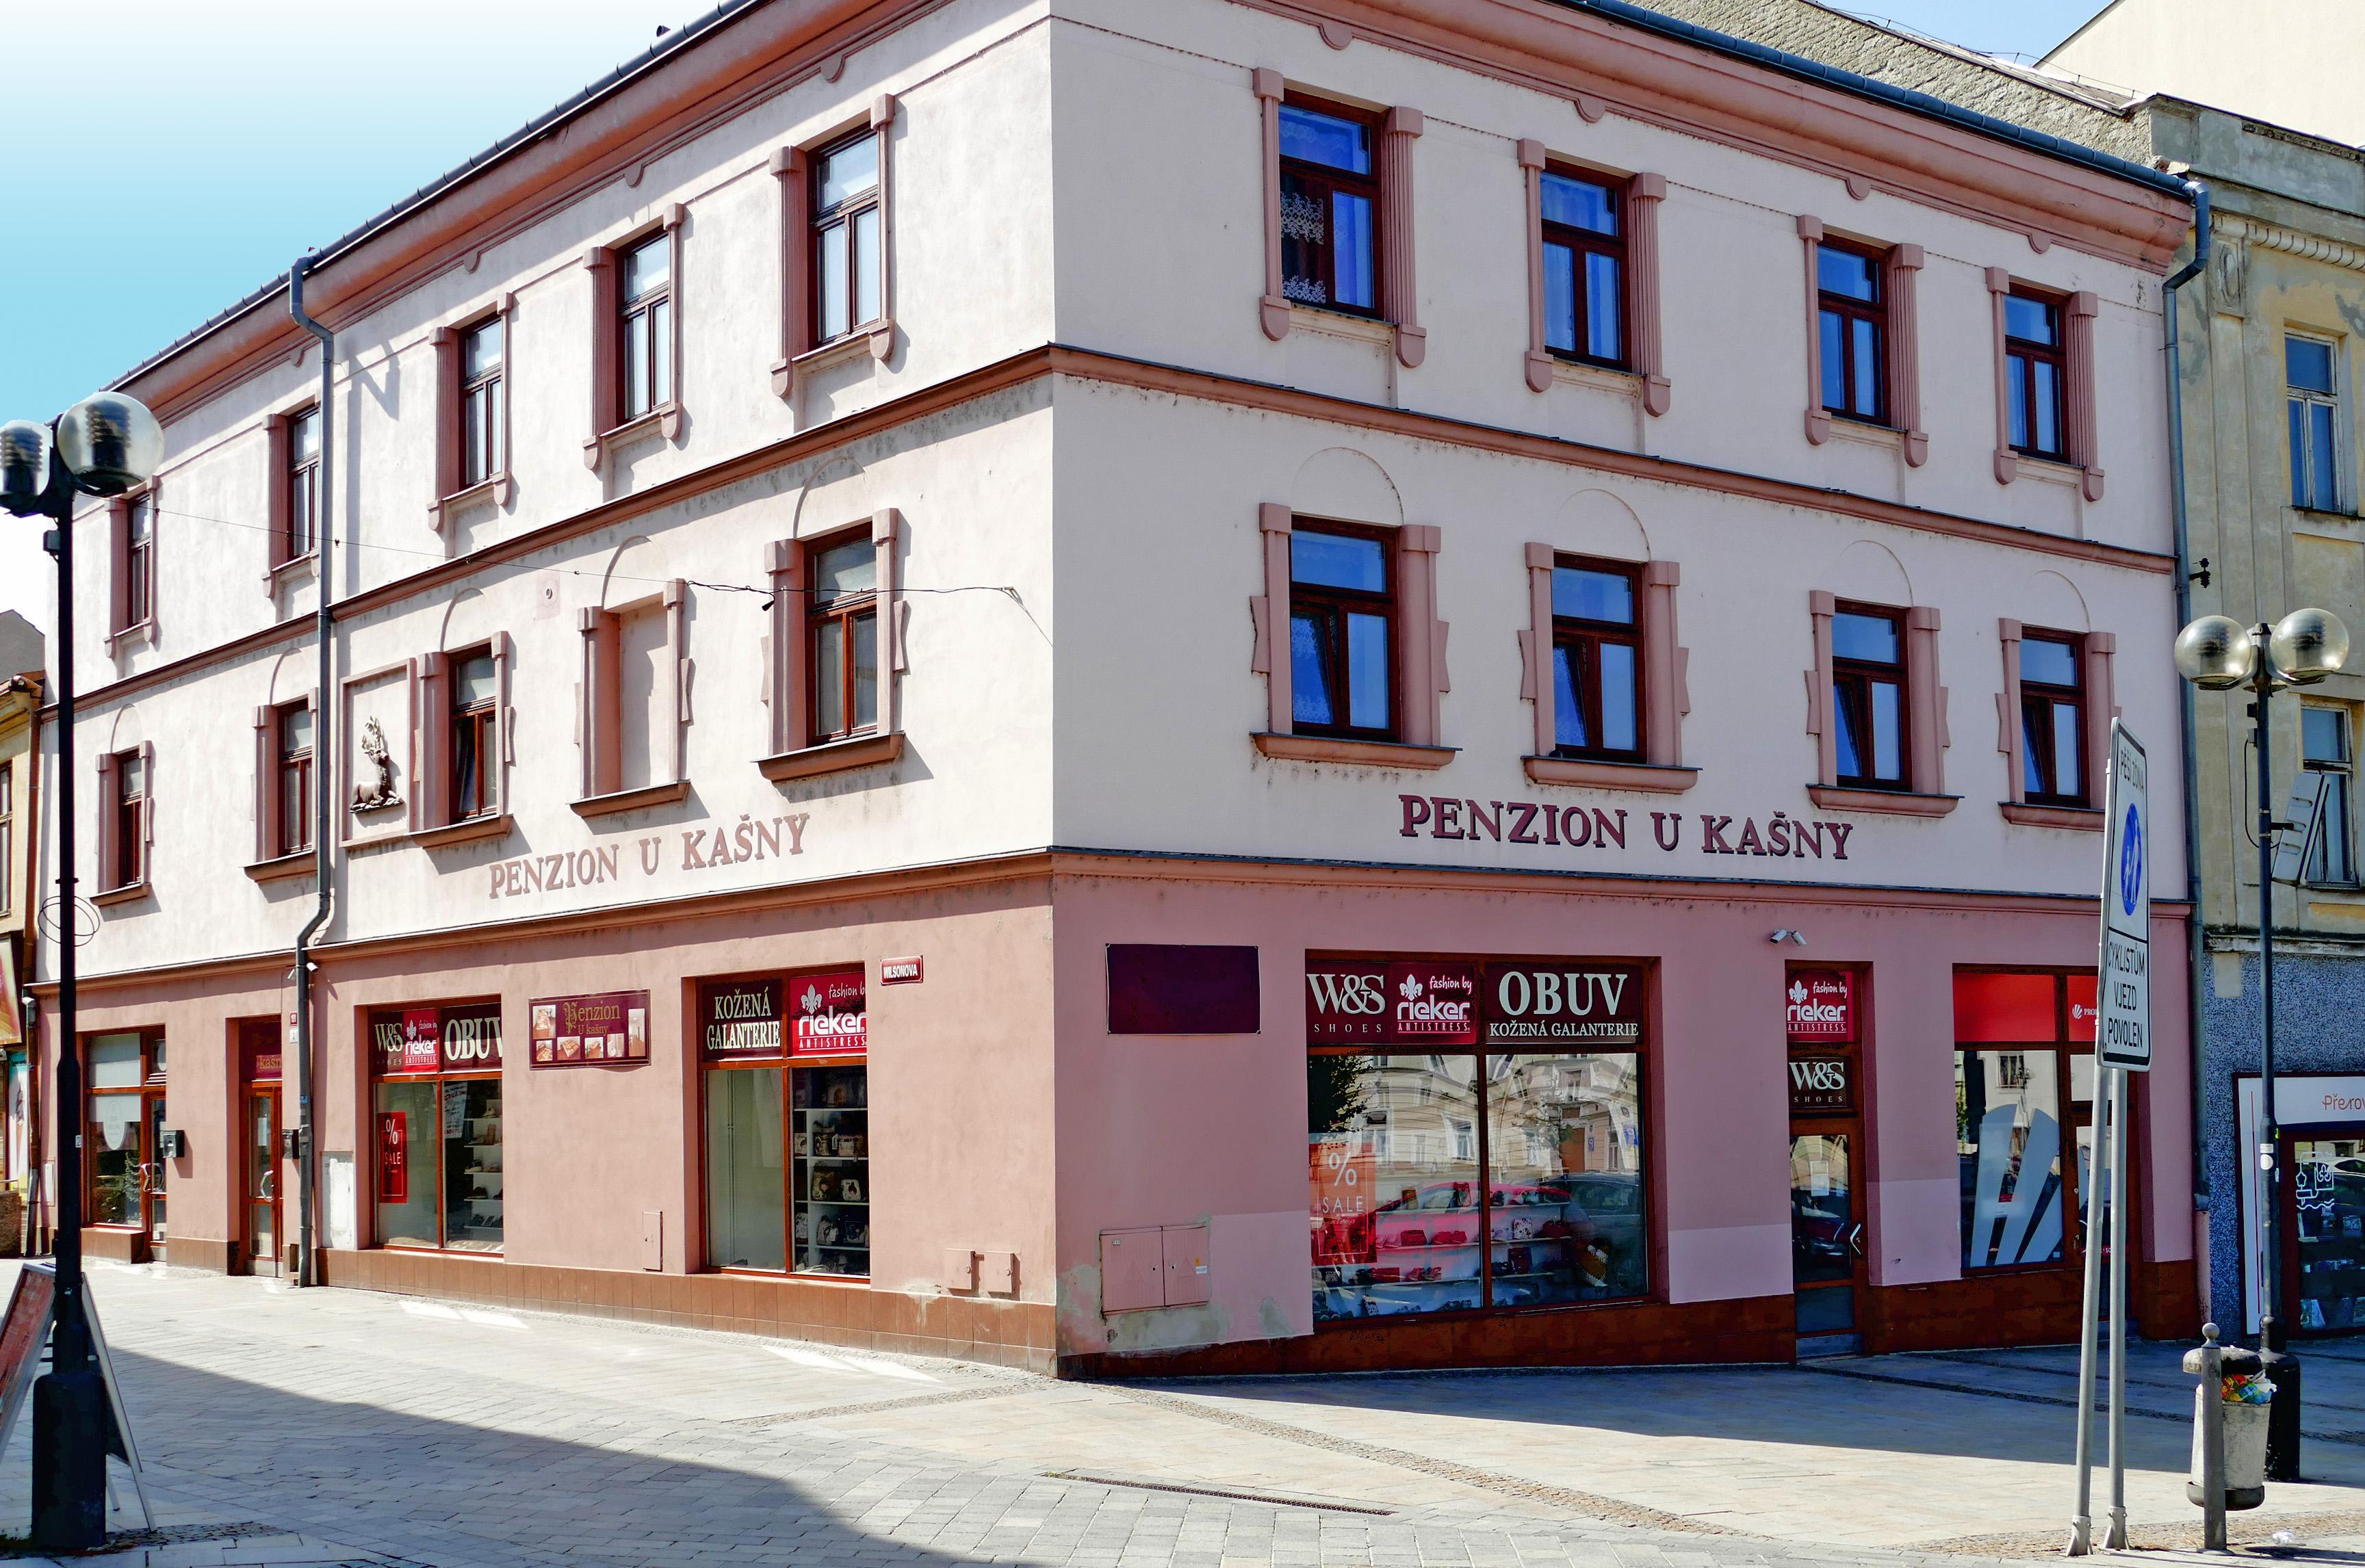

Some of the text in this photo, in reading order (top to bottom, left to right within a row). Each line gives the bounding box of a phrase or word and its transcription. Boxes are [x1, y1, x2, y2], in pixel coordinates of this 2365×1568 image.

[1398, 794, 1853, 860] PENZION U KAŠNY
[489, 813, 810, 899] PENZION U KAŠNY
[2108, 941, 2145, 977] CYKLISTŮM
[883, 964, 918, 978] WILSONOVA
[829, 980, 866, 999] fashion b
[1430, 975, 1472, 995] fashion by
[1499, 971, 1627, 1015] OBUV
[1813, 981, 1847, 998] fashion by
[714, 986, 771, 1019] KOŽENÁ
[2114, 981, 2136, 1011] VJEZD
[563, 1000, 621, 1034] Penzion
[1397, 995, 1471, 1020] rieker
[1787, 998, 1846, 1021] rieker
[586, 1024, 608, 1036] kašny
[707, 1021, 780, 1050] GALANTERIE
[1314, 1023, 1382, 1033] SHOES
[1398, 1022, 1469, 1031] ANTISTRESS
[1490, 1020, 1639, 1036] KOŽENÁ GALANTERIE
[1788, 1023, 1844, 1032] ANTISTRESS
[2108, 1017, 2143, 1047] POVOLEN
[405, 1034, 437, 1055] rieker
[799, 1036, 865, 1049] ANTISTRESS
[259, 1055, 281, 1069] kašn
[385, 1152, 401, 1164] SALE
[1322, 1196, 1363, 1214] SALE
